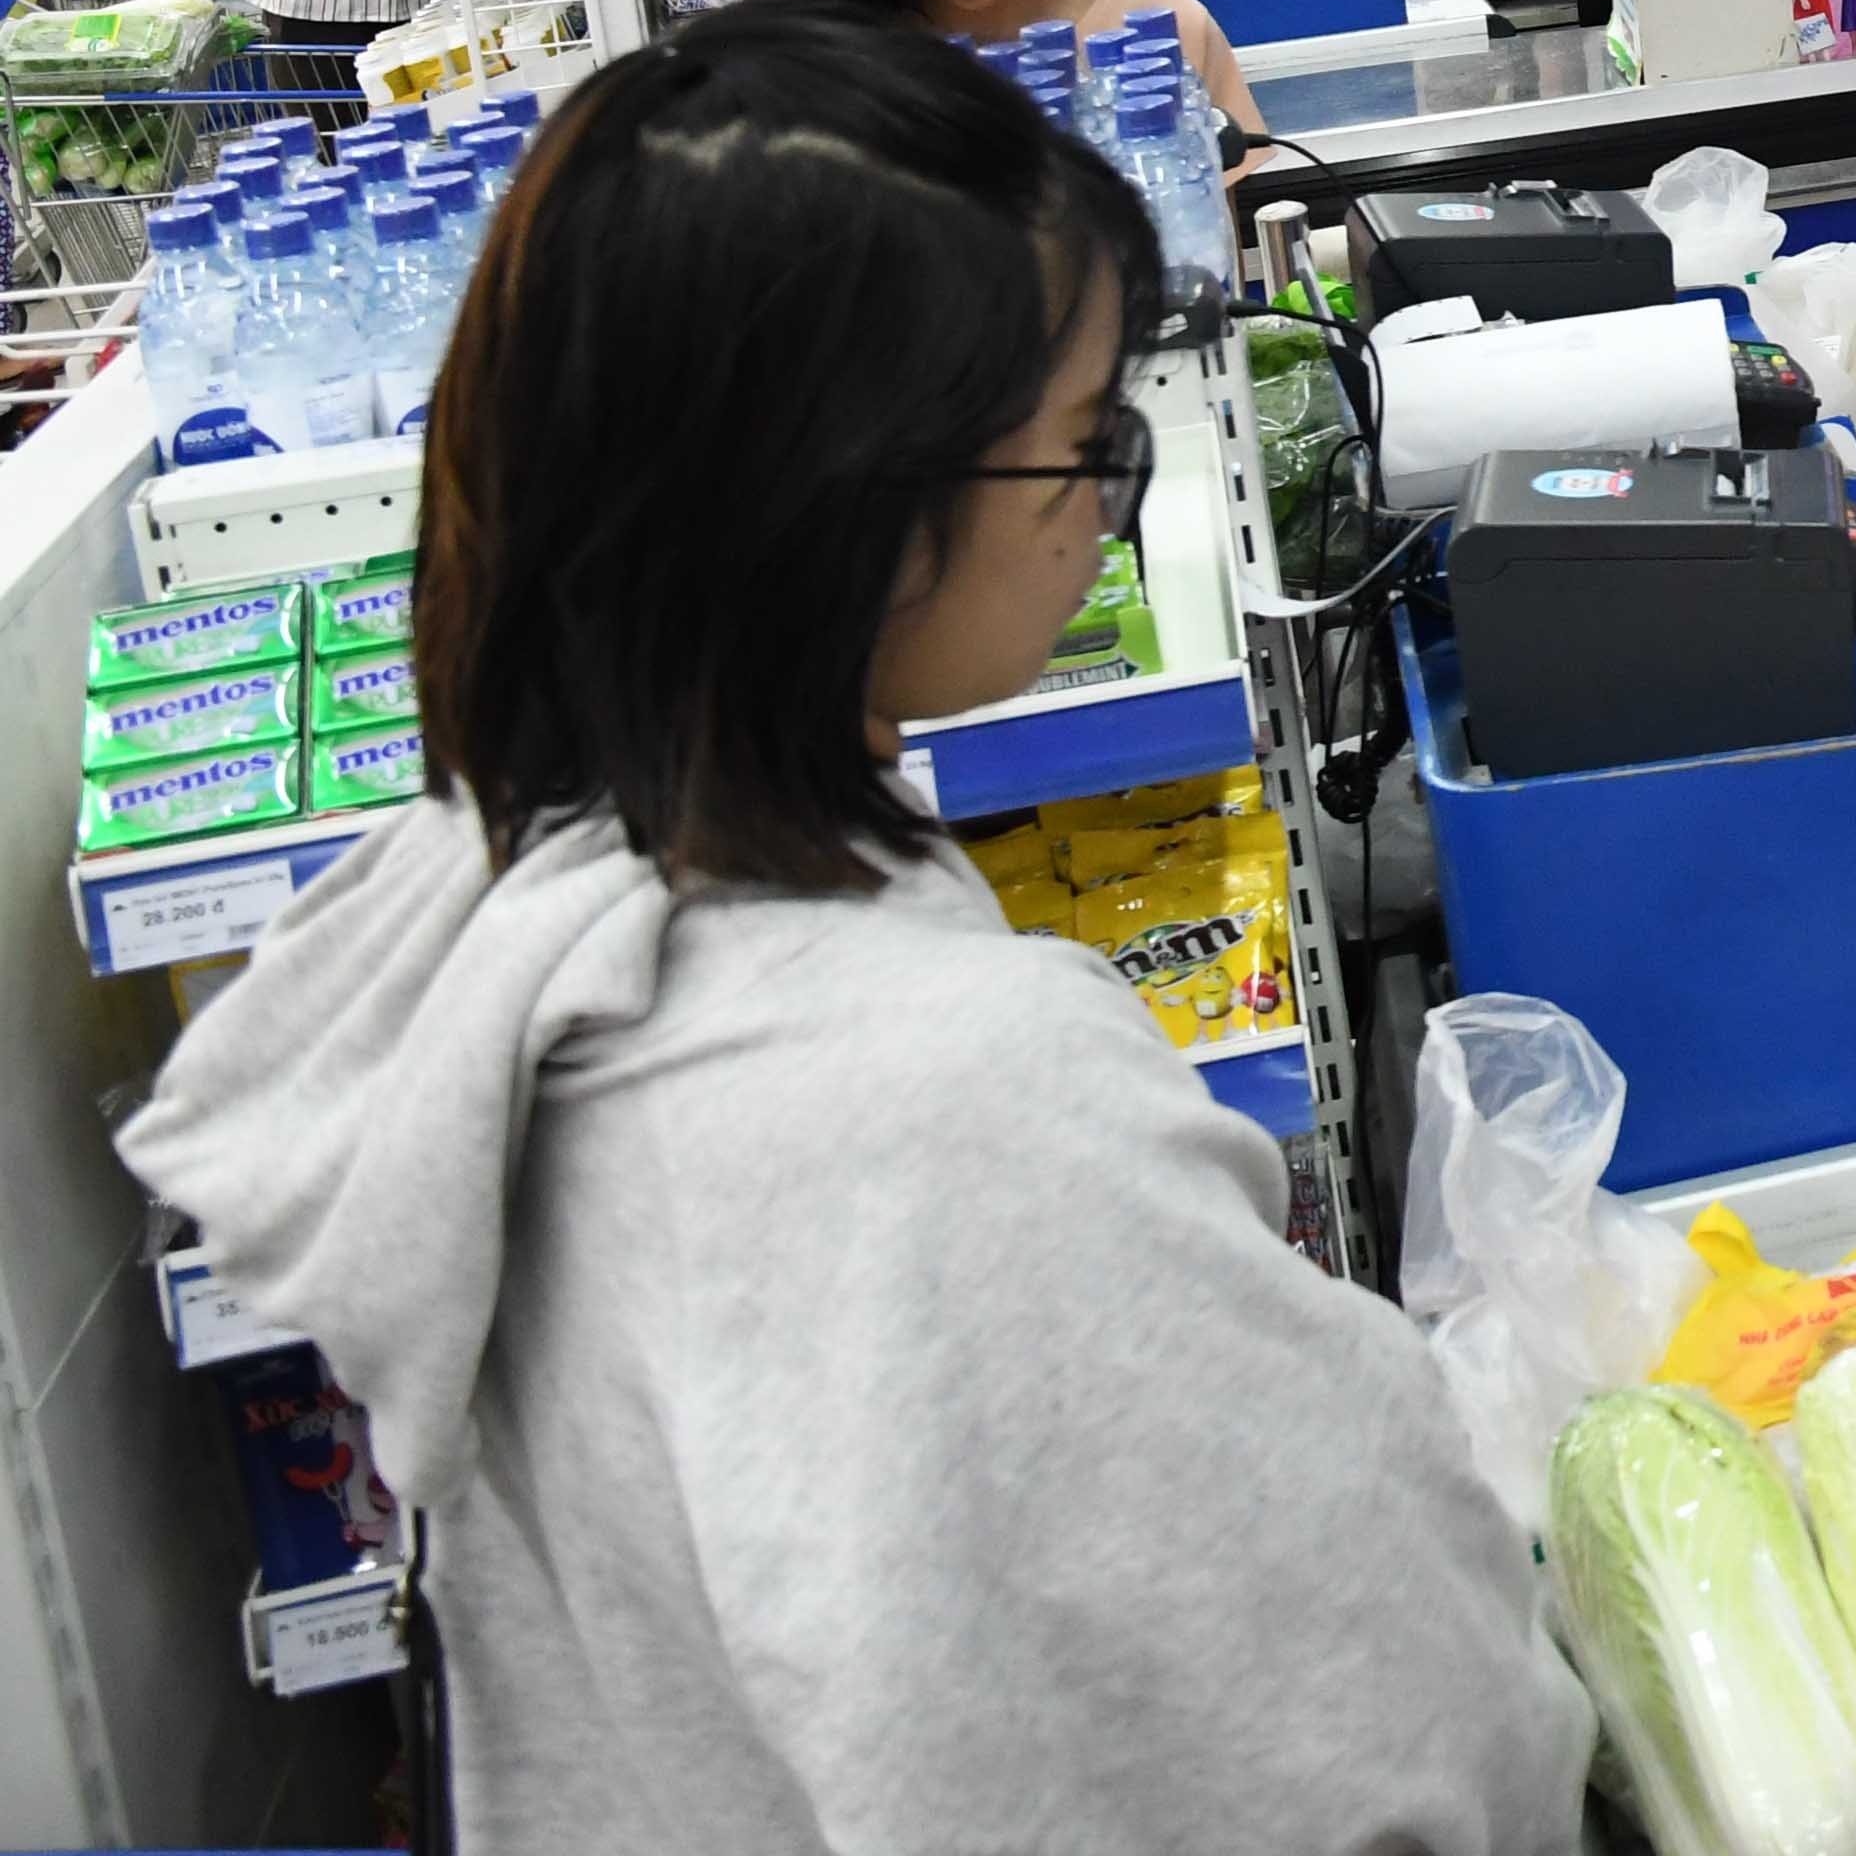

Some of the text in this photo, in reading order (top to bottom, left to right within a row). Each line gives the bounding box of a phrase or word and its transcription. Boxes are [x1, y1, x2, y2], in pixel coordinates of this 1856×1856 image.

[115, 593, 276, 654] mentos
[110, 672, 275, 736] mentos
[108, 749, 275, 813] mentos
